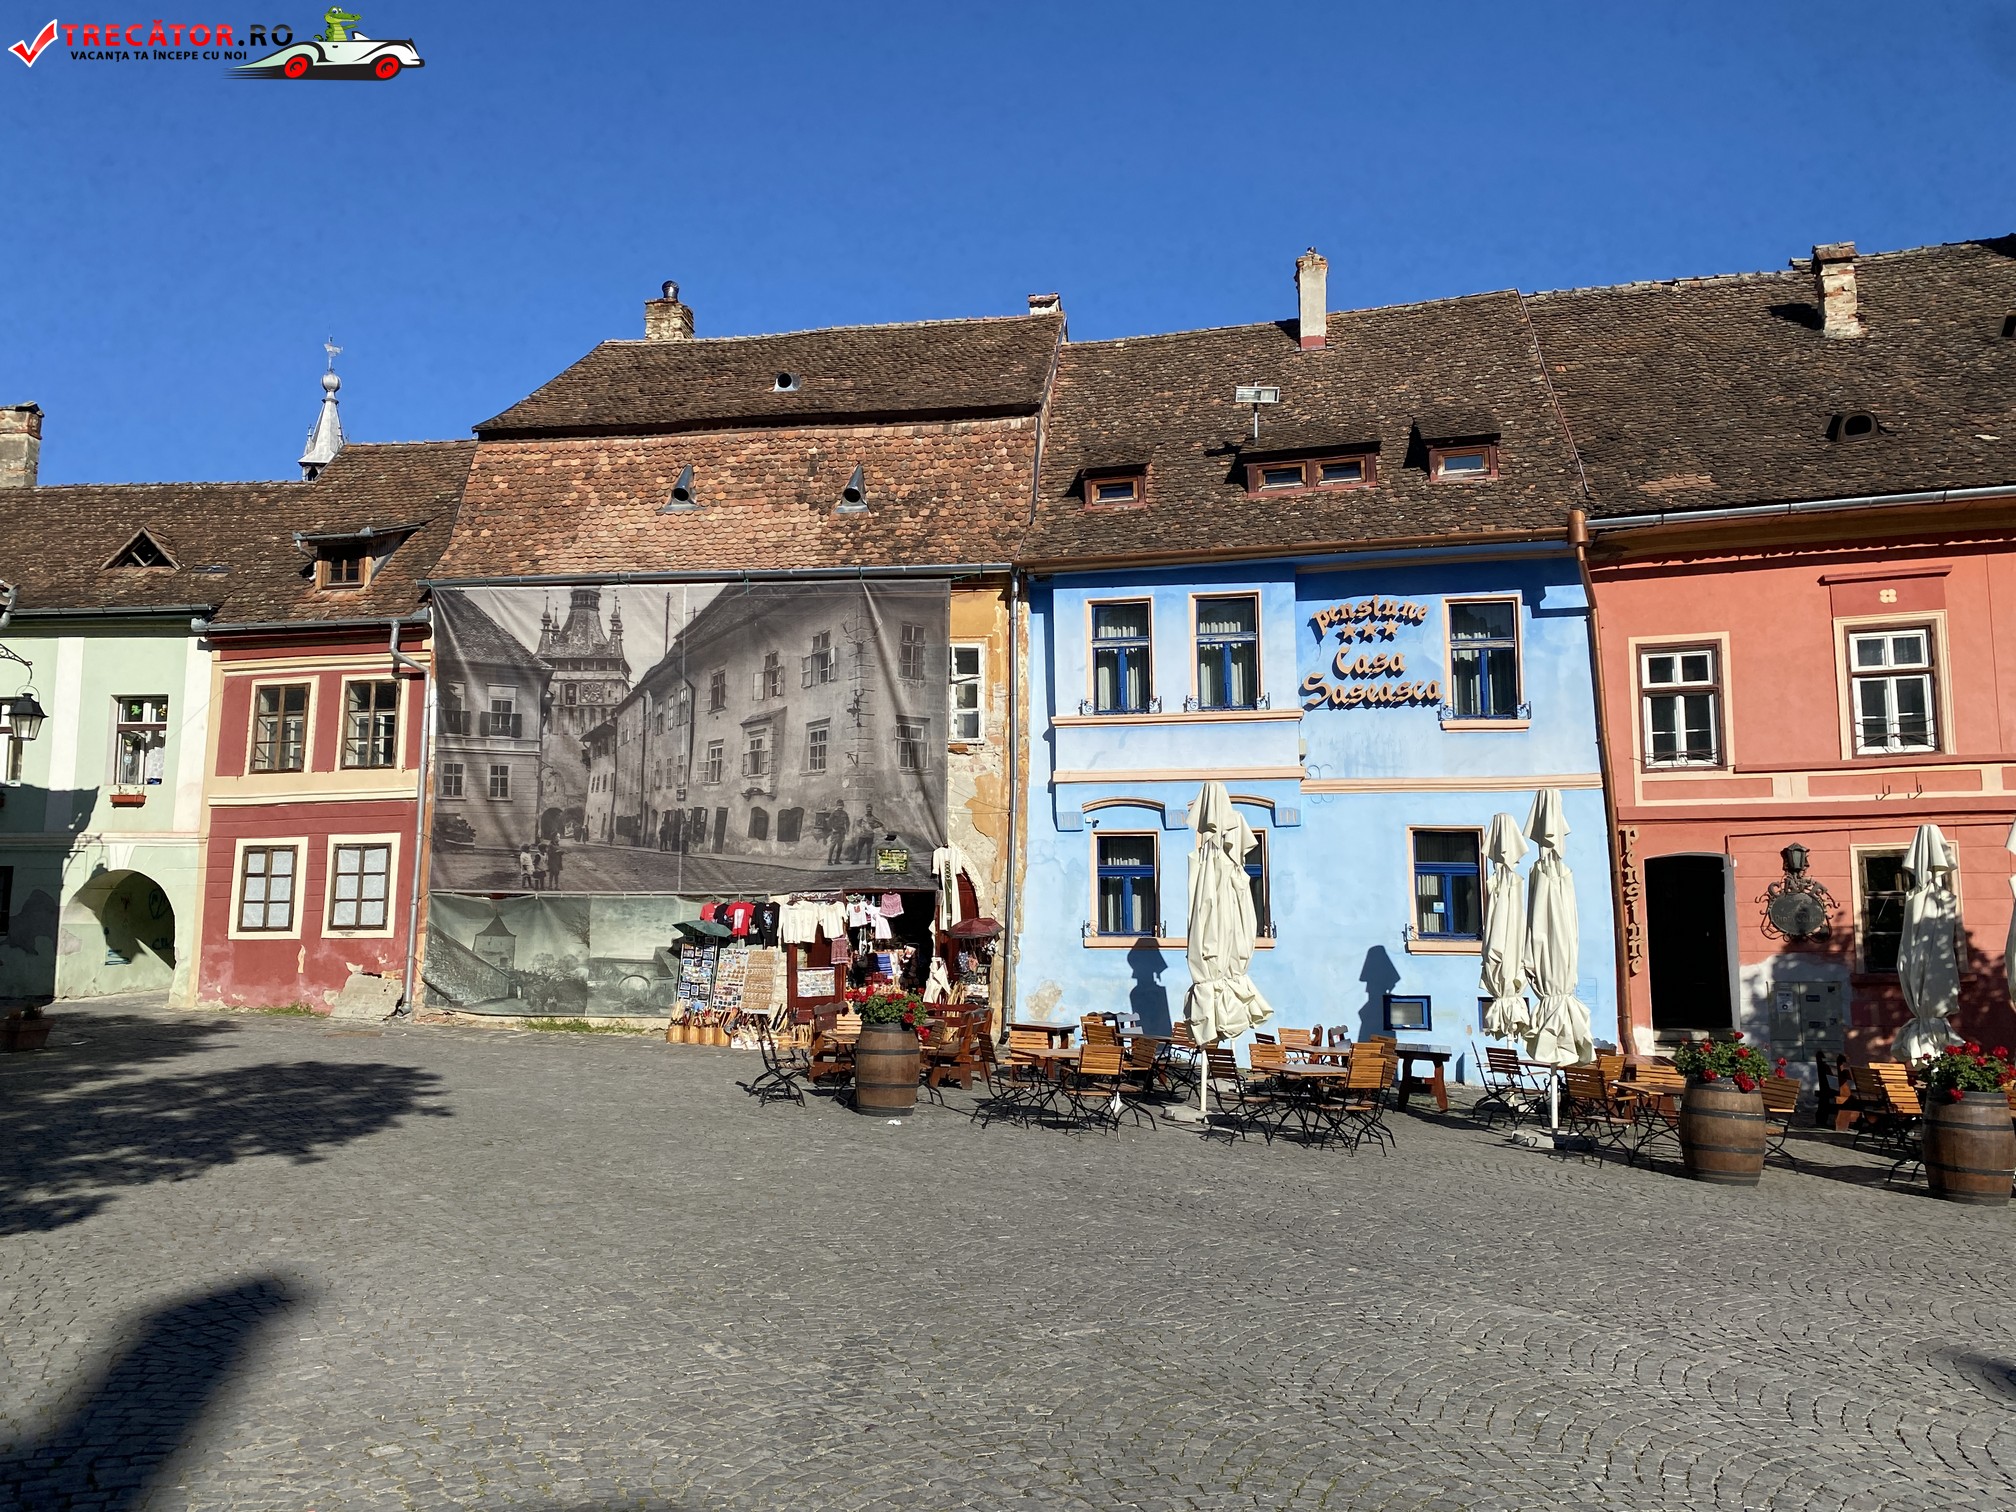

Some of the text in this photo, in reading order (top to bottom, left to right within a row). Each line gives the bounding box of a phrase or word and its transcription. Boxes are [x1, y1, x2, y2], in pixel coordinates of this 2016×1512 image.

[1311, 594, 1430, 636] pensiune
[1335, 646, 1407, 676] Casa
[1302, 671, 1444, 706] Saseasca
